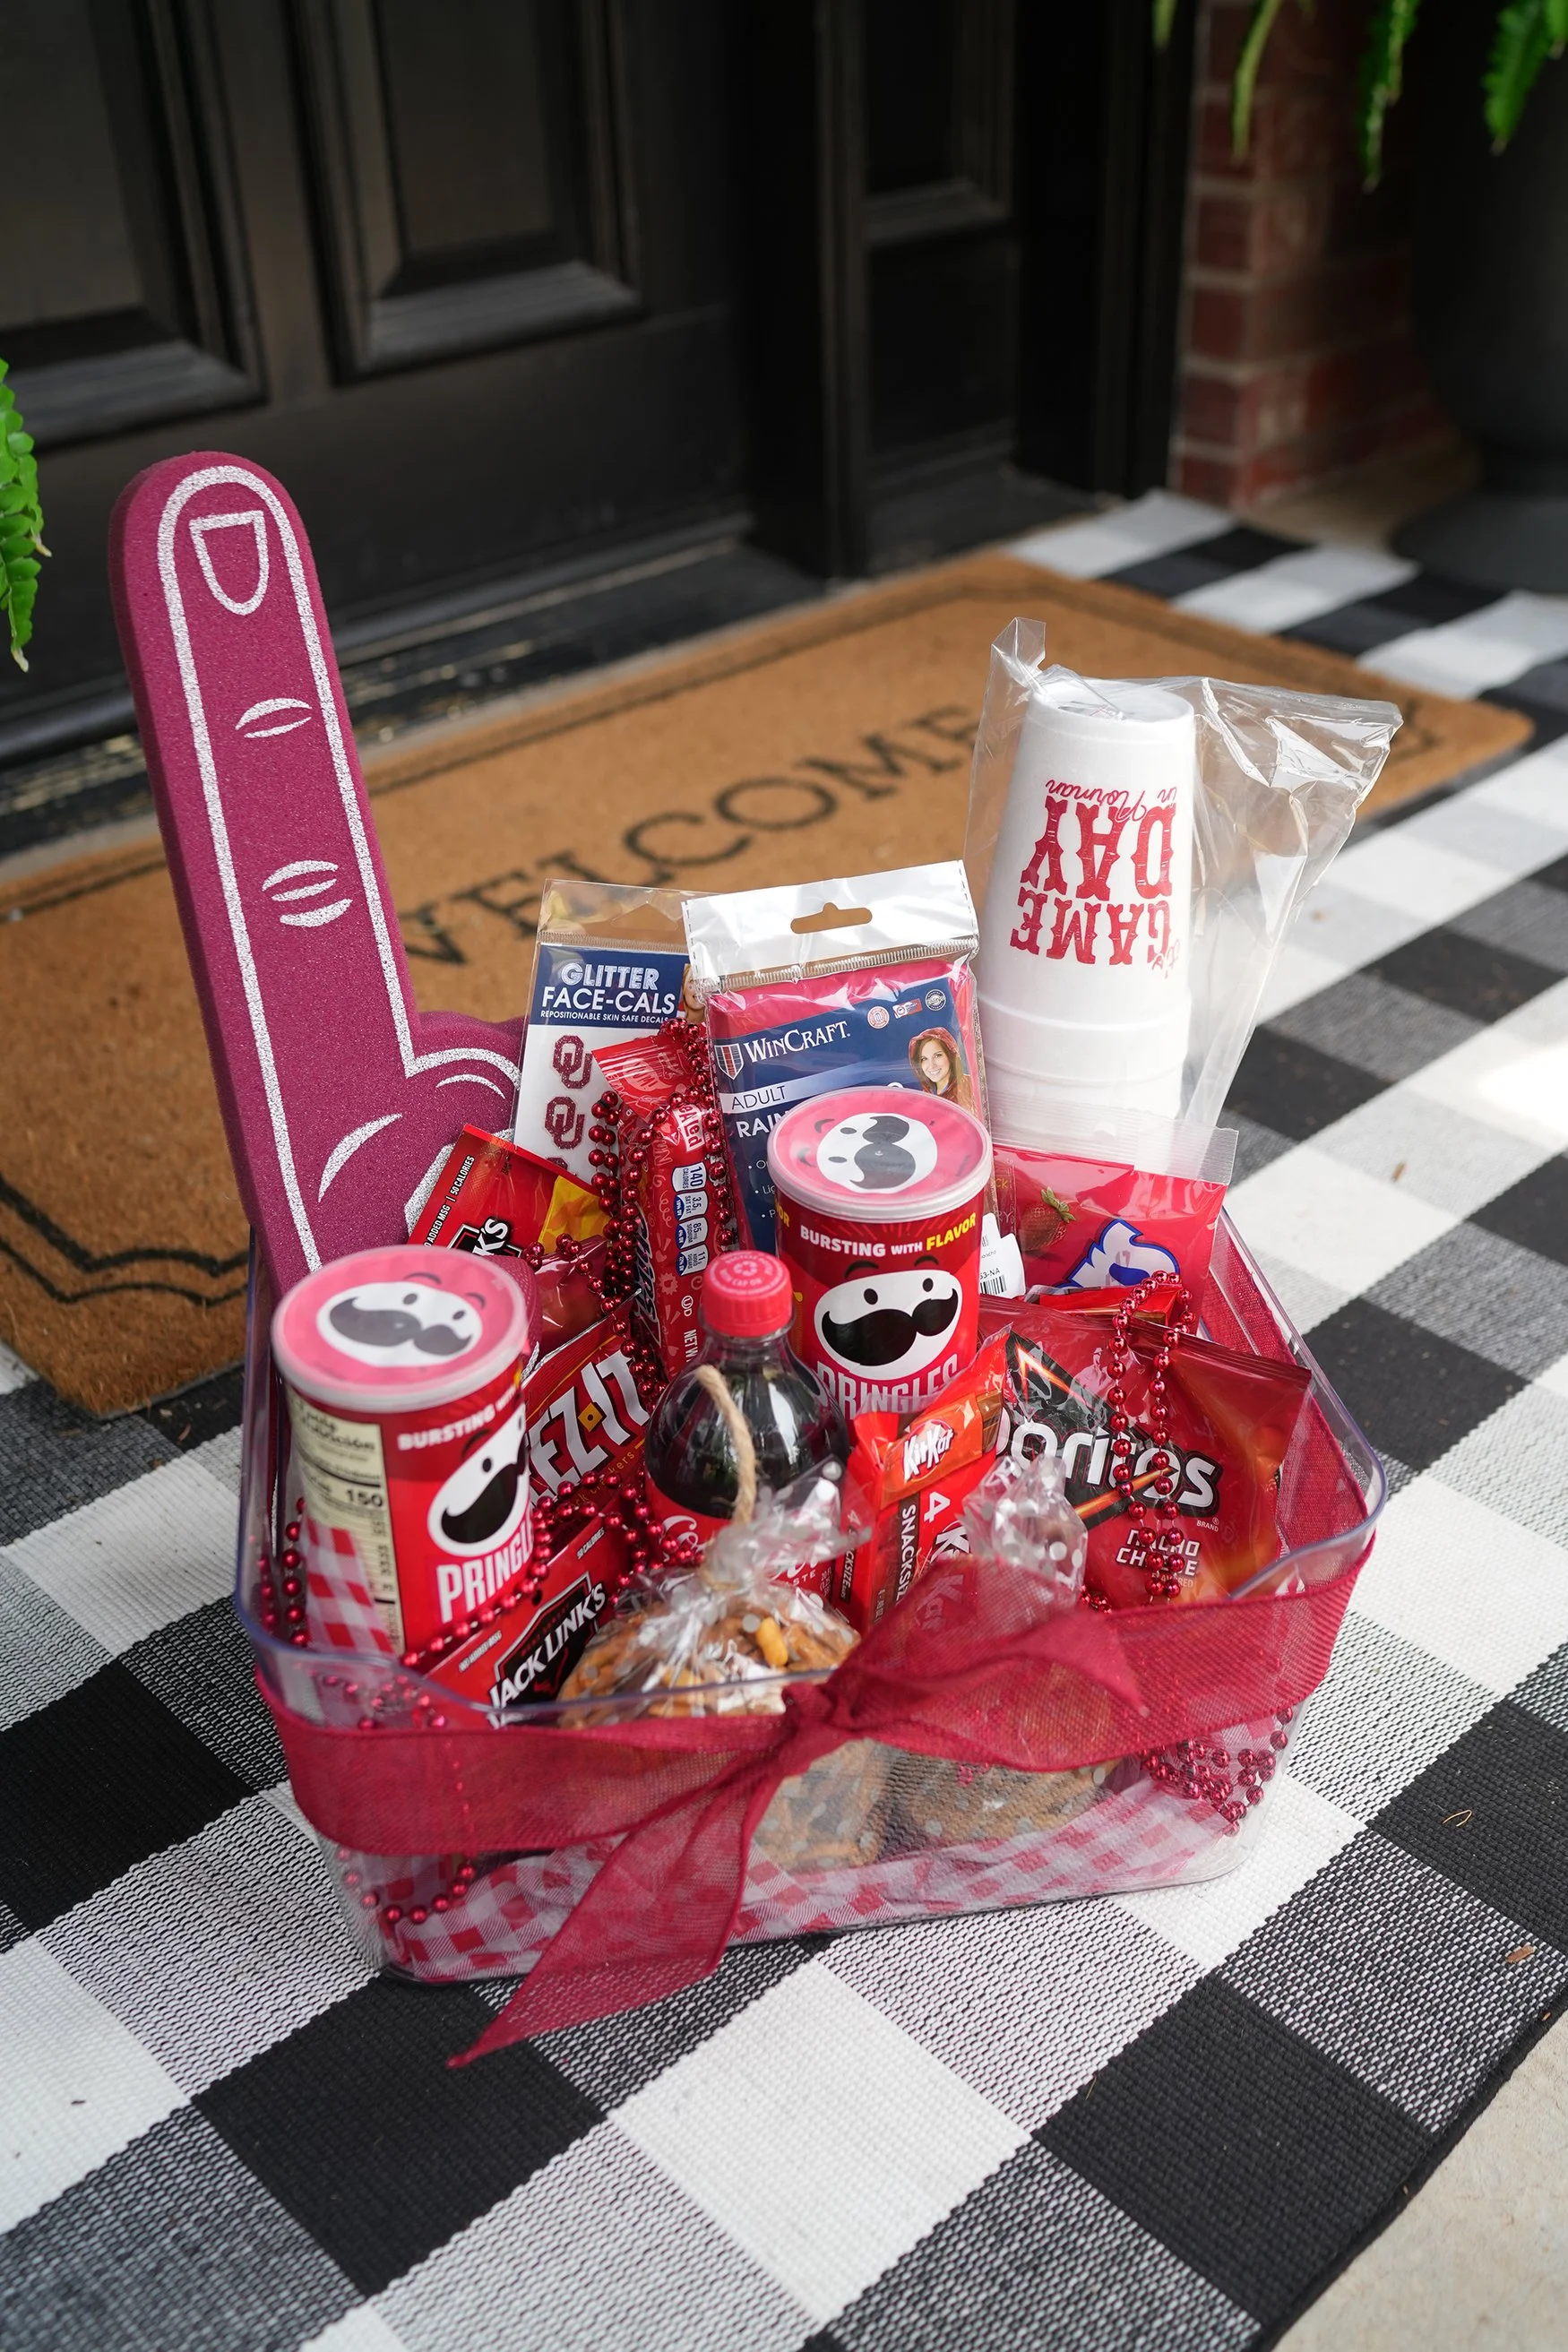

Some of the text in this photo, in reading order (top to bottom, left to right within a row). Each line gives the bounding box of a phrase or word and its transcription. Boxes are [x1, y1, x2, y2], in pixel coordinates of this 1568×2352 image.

[1045, 779, 1147, 822] Norman
[1021, 796, 1176, 901] DAY
[1010, 887, 1172, 966] GAME
[561, 962, 660, 991] GLITTER
[541, 986, 676, 1015] FACE-CALS
[540, 1010, 601, 1021] REPOSITIONABLE
[602, 1012, 620, 1022] SKIN
[621, 1014, 639, 1023] SAFE
[731, 1085, 787, 1110] ADULT
[454, 1156, 475, 1187] CALORIES
[690, 1167, 702, 1187] 140
[450, 1185, 460, 1195] 50
[437, 1204, 451, 1221] MSG
[426, 1219, 443, 1243] ADDED
[800, 1211, 978, 1258] BURSTING WITH FLAVOR
[684, 1329, 697, 1346] NET
[397, 1403, 495, 1451] BURSTING
[346, 1488, 383, 1508] 150
[924, 1491, 951, 1523] 4
[1196, 1519, 1219, 1533] BRAND
[896, 1503, 917, 1603] SNACKSIZ
[1126, 1529, 1201, 1557] NCHO
[436, 1520, 534, 1624] PRINGL
[489, 1649, 547, 1710] JACK
[544, 1582, 606, 1661] LINK'S
